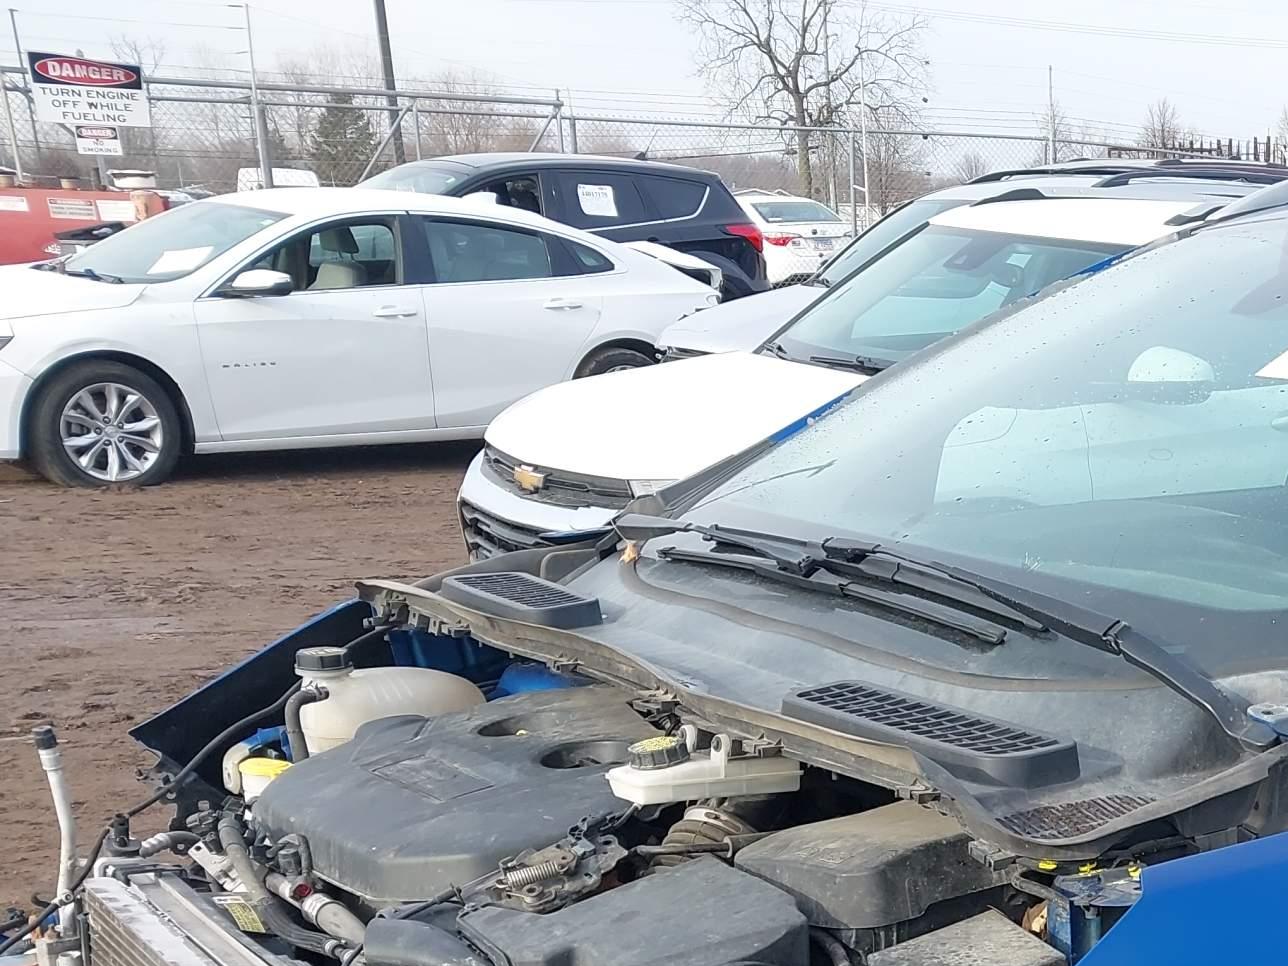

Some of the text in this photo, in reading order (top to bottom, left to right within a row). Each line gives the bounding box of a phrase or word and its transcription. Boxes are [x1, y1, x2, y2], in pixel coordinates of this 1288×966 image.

[46, 61, 125, 81] DANGER
[39, 87, 140, 101] TURN ENGINE
[51, 99, 133, 112] OFF WHILE
[62, 111, 127, 123] FUELING
